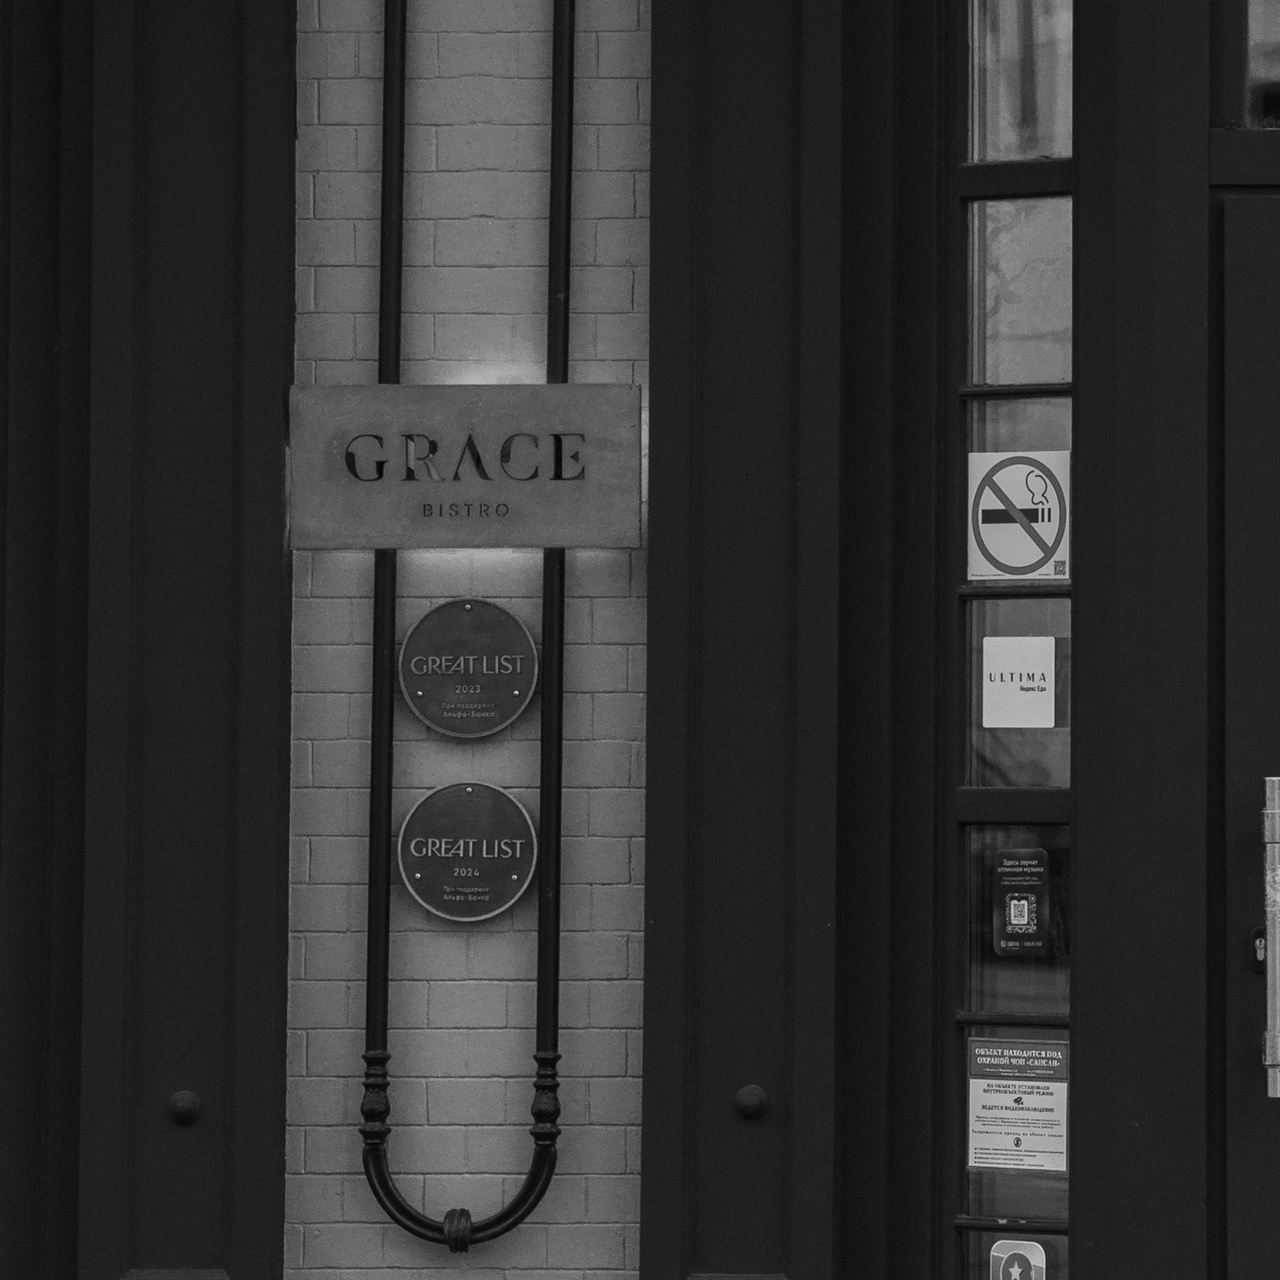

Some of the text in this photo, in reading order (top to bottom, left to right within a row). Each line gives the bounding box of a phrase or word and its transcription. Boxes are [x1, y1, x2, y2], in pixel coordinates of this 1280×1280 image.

[344, 432, 587, 483] GRACE
[422, 503, 510, 519] BISTRO
[410, 655, 526, 675] GREAT LIST
[989, 672, 1047, 683] ULTIMA
[455, 685, 482, 694] 2023
[410, 838, 526, 858] GREAT LIST
[453, 868, 480, 877] 2024
